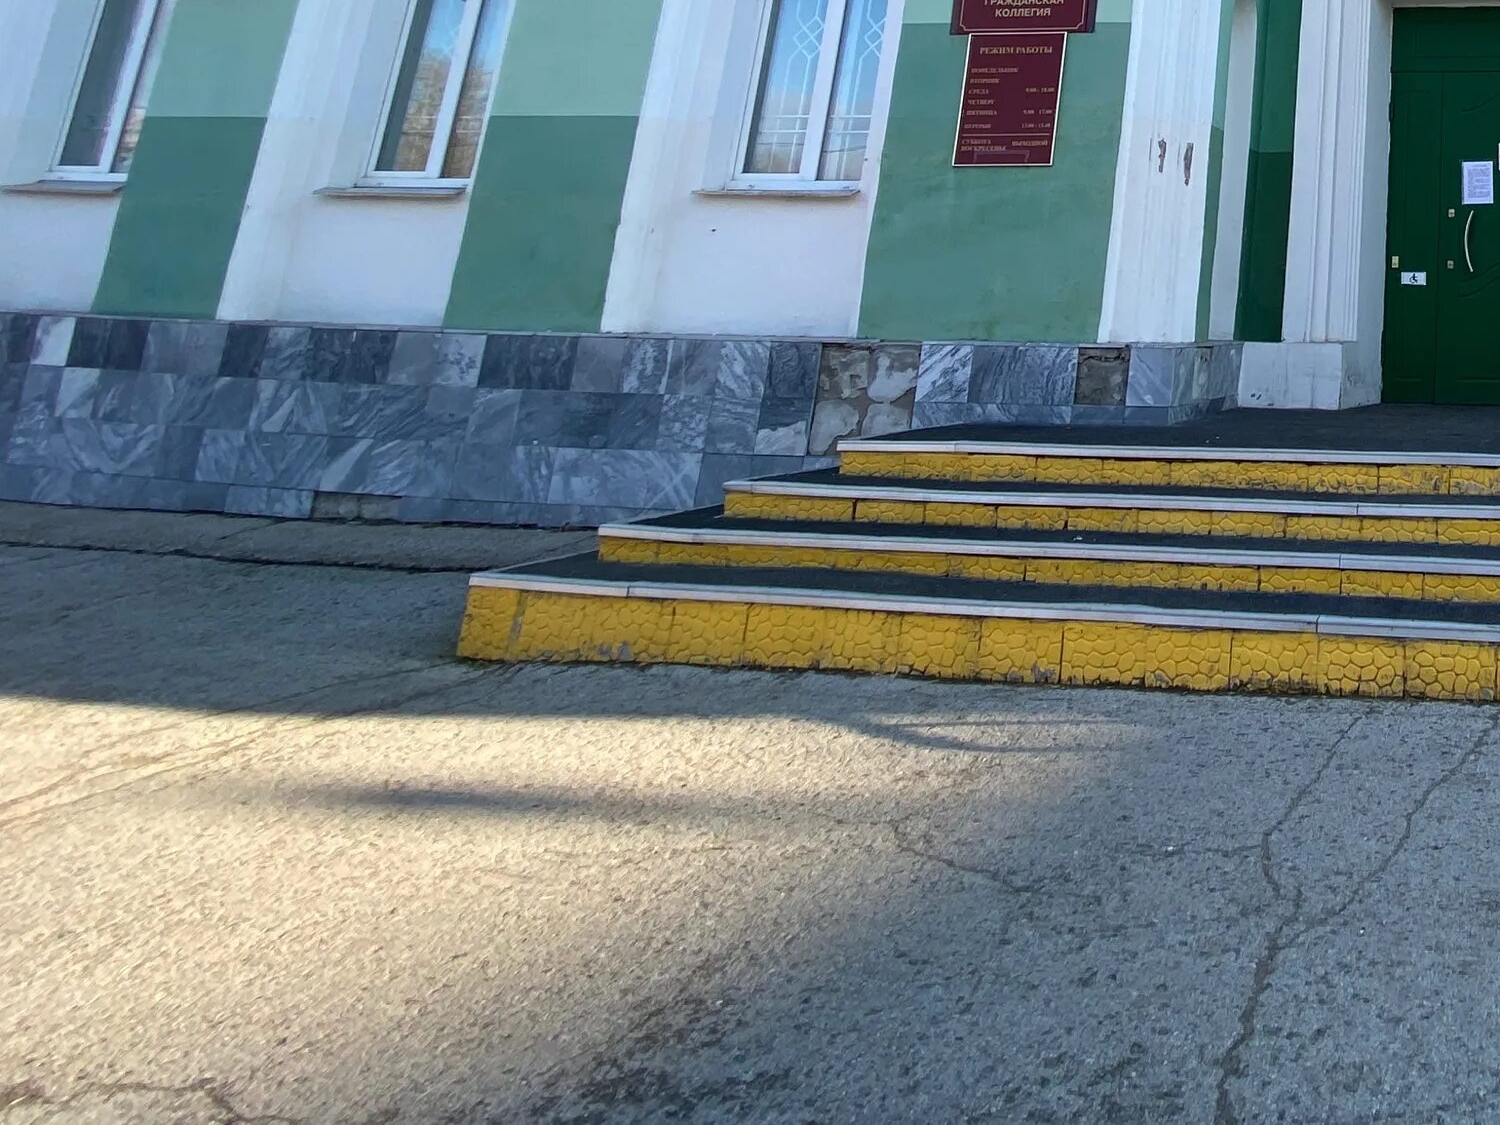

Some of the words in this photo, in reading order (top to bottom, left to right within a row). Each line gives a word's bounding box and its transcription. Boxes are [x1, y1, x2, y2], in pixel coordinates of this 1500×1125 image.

[995, 8, 1051, 18] КОЛЛЕГИЯ
[979, 46, 1014, 55] РЕЖИМ
[1016, 46, 1053, 54] РАБОТЫ
